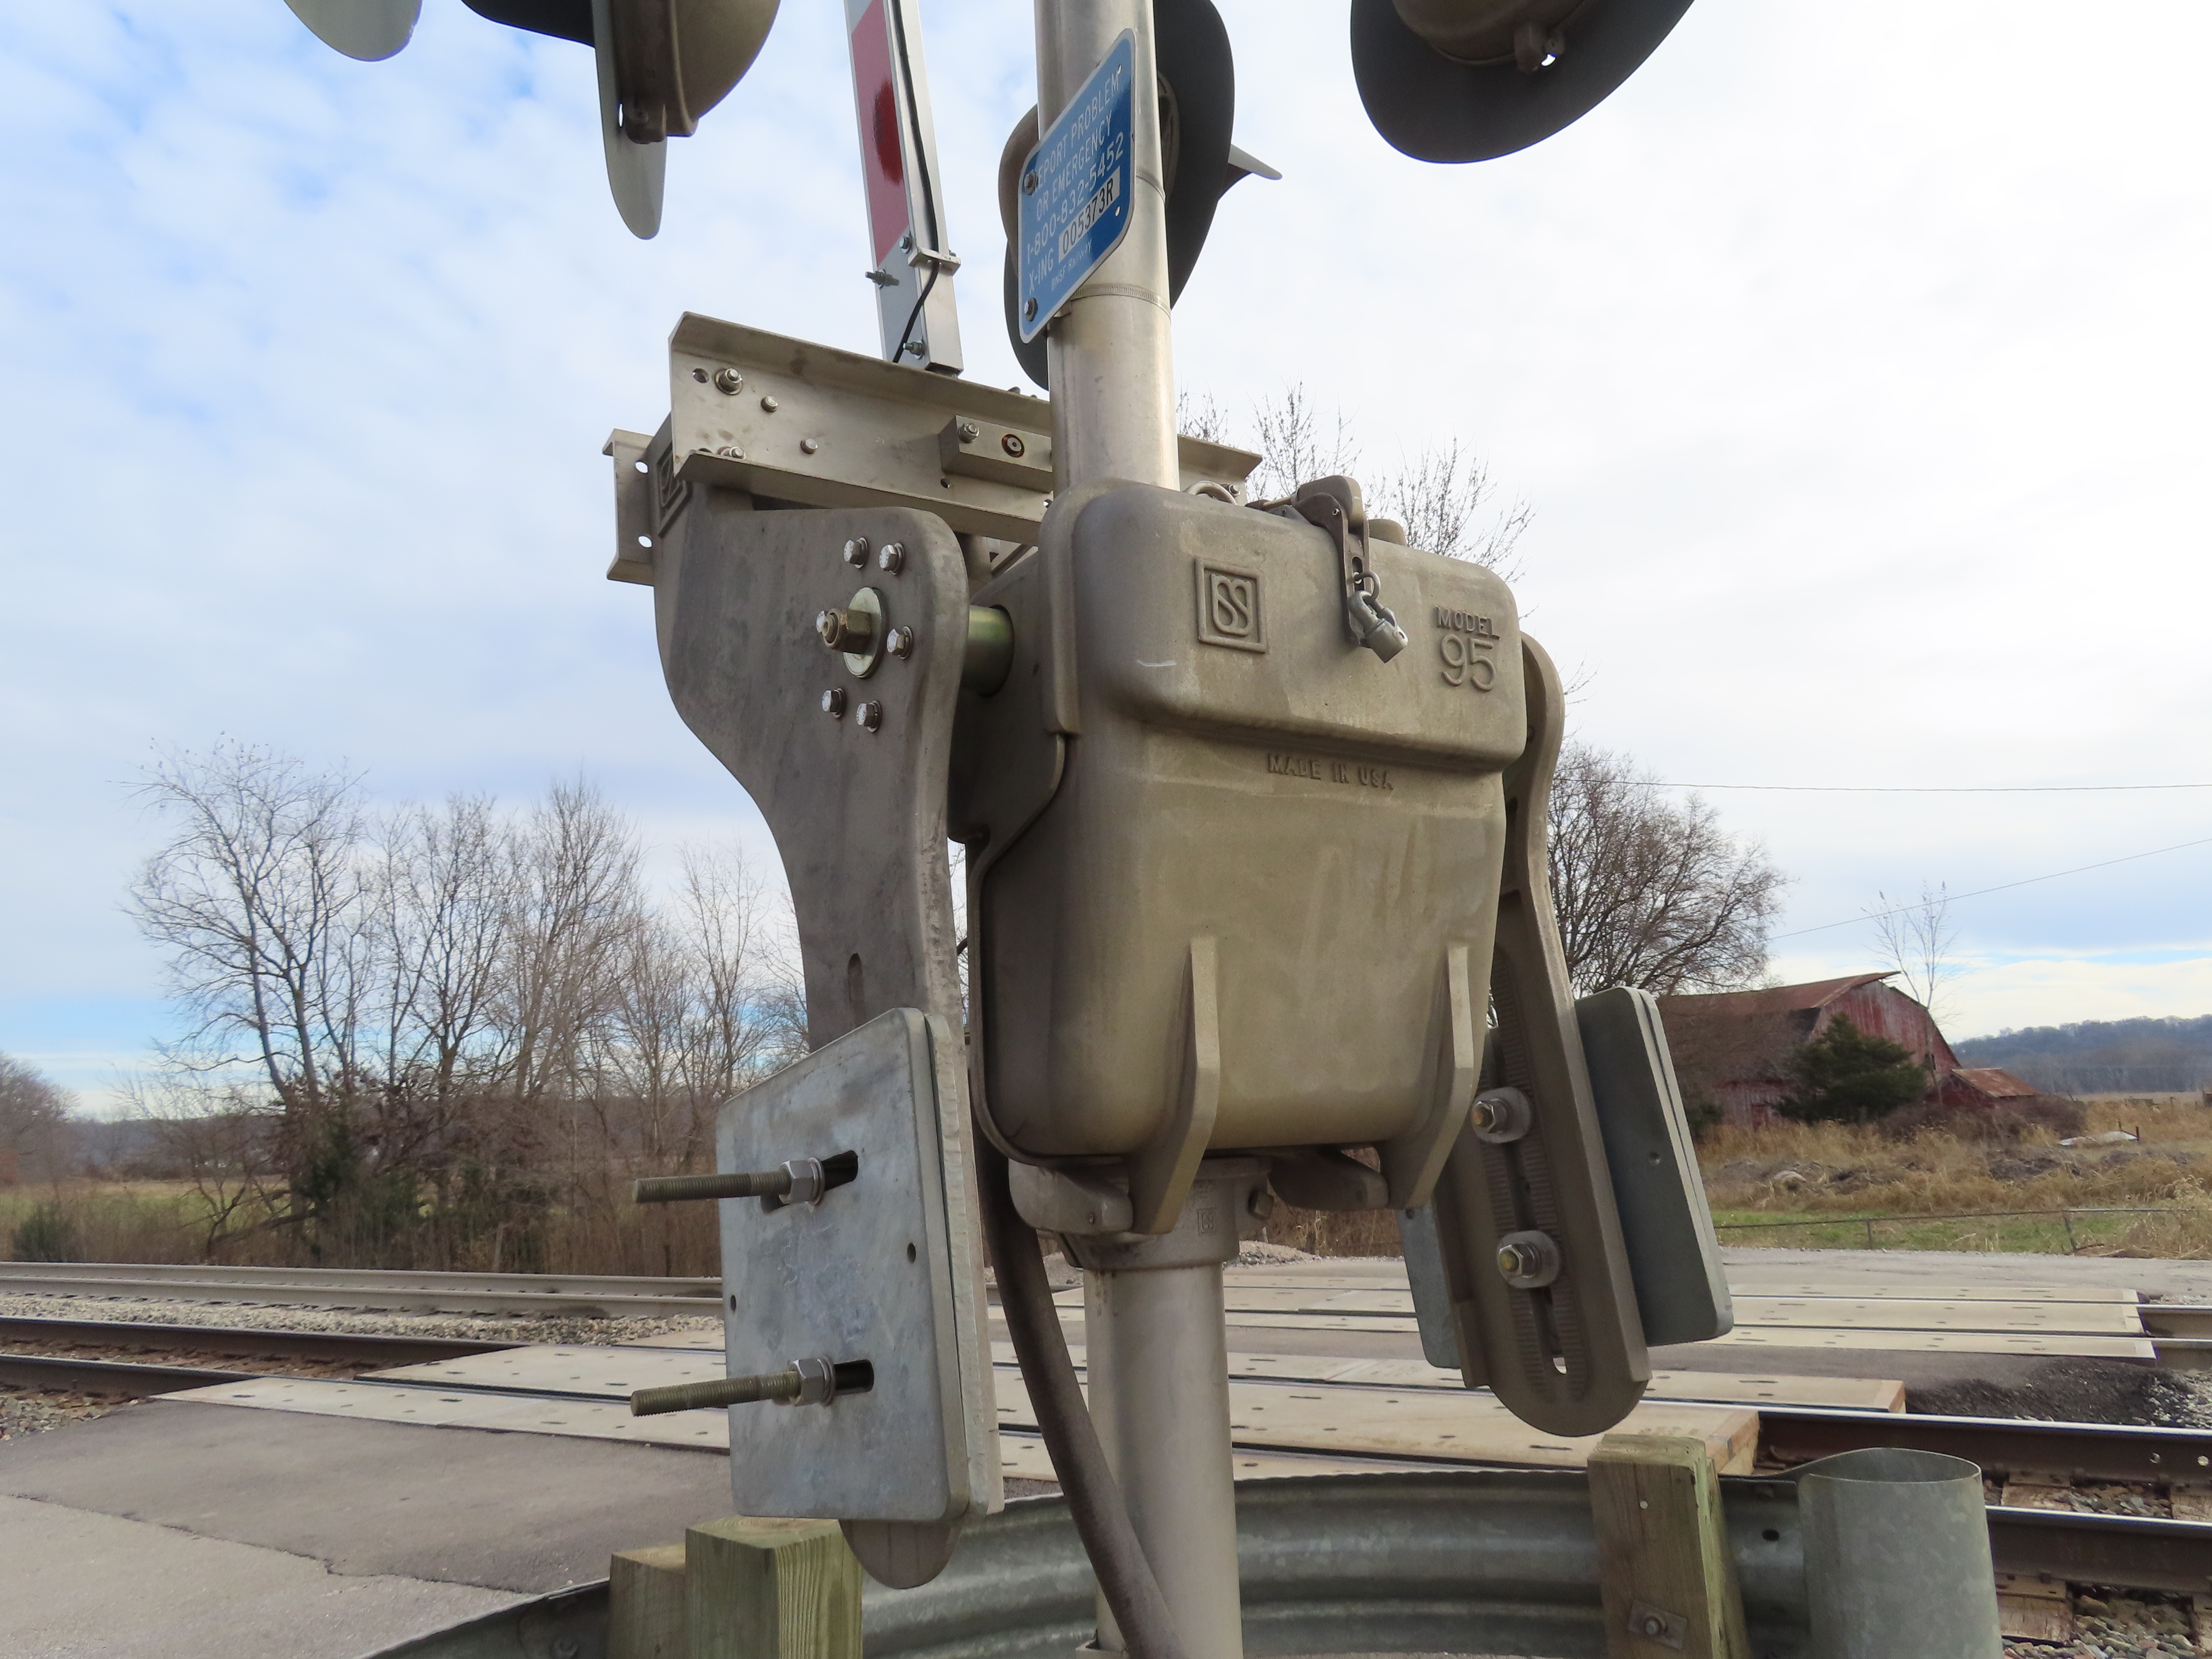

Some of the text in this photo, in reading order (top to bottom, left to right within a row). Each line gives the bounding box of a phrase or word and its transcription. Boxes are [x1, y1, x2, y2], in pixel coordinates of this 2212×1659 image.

[1032, 71, 1119, 197] EPORT PROBLEM
[1037, 109, 1112, 221] OR EMERGENCY
[1027, 132, 1124, 265] 1-800-832-5452
[1029, 178, 1114, 295] X-ING 005373R
[1051, 238, 1093, 291] BNSF Railway
[1434, 605, 1500, 640] MODEL
[1440, 633, 1496, 692] 95
[1268, 753, 1394, 790] MADE IN USA
